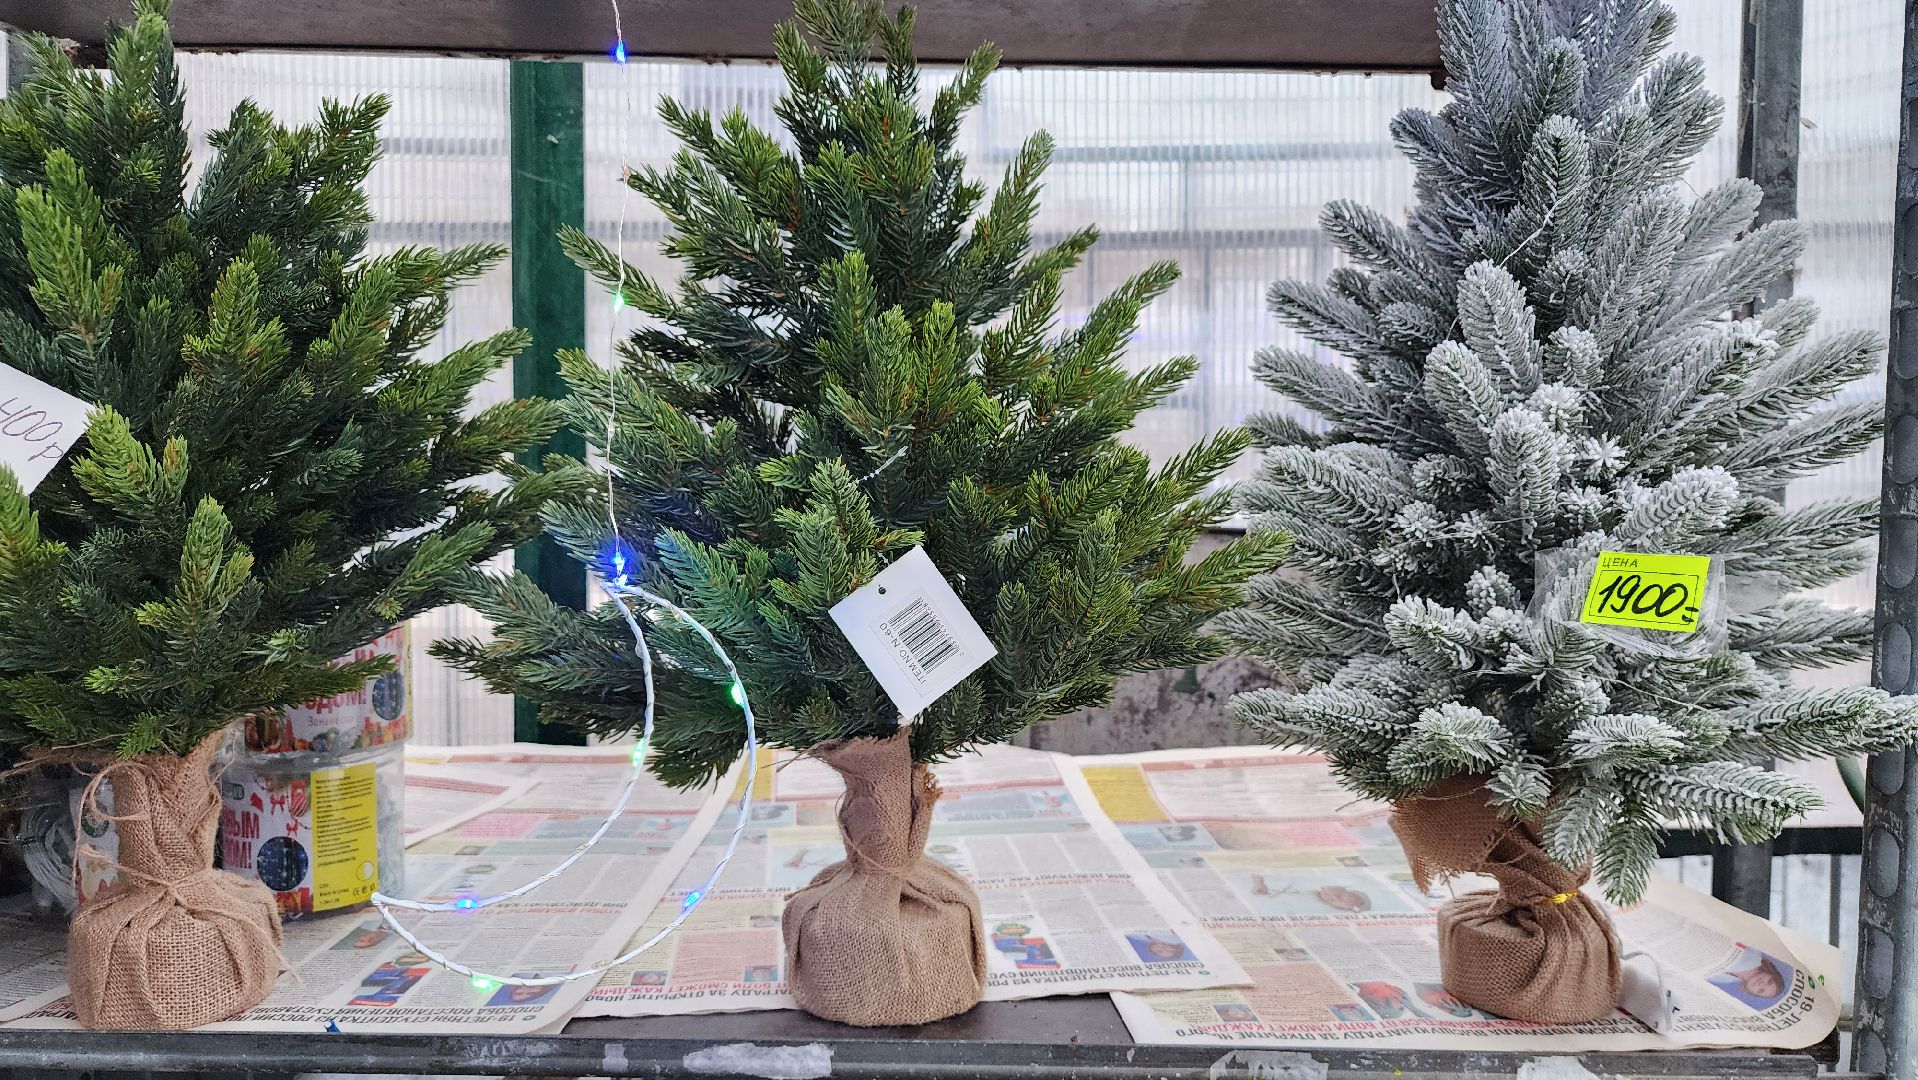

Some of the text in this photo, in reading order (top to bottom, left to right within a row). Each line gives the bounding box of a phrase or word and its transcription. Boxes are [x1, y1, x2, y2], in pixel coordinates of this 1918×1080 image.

[1602, 557, 1638, 569] ЦЕНА
[878, 621, 901, 648] N-60
[906, 661, 927, 685] ITEM
[1019, 964, 1142, 978] ВОССТАНОВЛЕНИЯ
[1144, 962, 1205, 971] СПОСОБА
[1012, 977, 1031, 985] ИЗ
[1034, 972, 1114, 983] СТУДЕНТКА
[669, 982, 728, 993] СМОЖЕТ
[627, 990, 704, 1001] ОТКРЫТИЕ
[1763, 969, 1805, 1021] СПОСОБА
[335, 1007, 474, 1015] ВОССТАНОВЛЕНИЯ
[477, 1006, 544, 1015] СПОСОБА
[252, 1014, 314, 1022] РОССИИ
[339, 1015, 430, 1023] СТУДЕНТКА
[1268, 1024, 1331, 1033] СМОЖЕТ
[1343, 1027, 1413, 1039] НАГРАДУ
[1236, 1031, 1316, 1040] ОТКРЫТИЕ
[1319, 1032, 1340, 1040] ЗА
